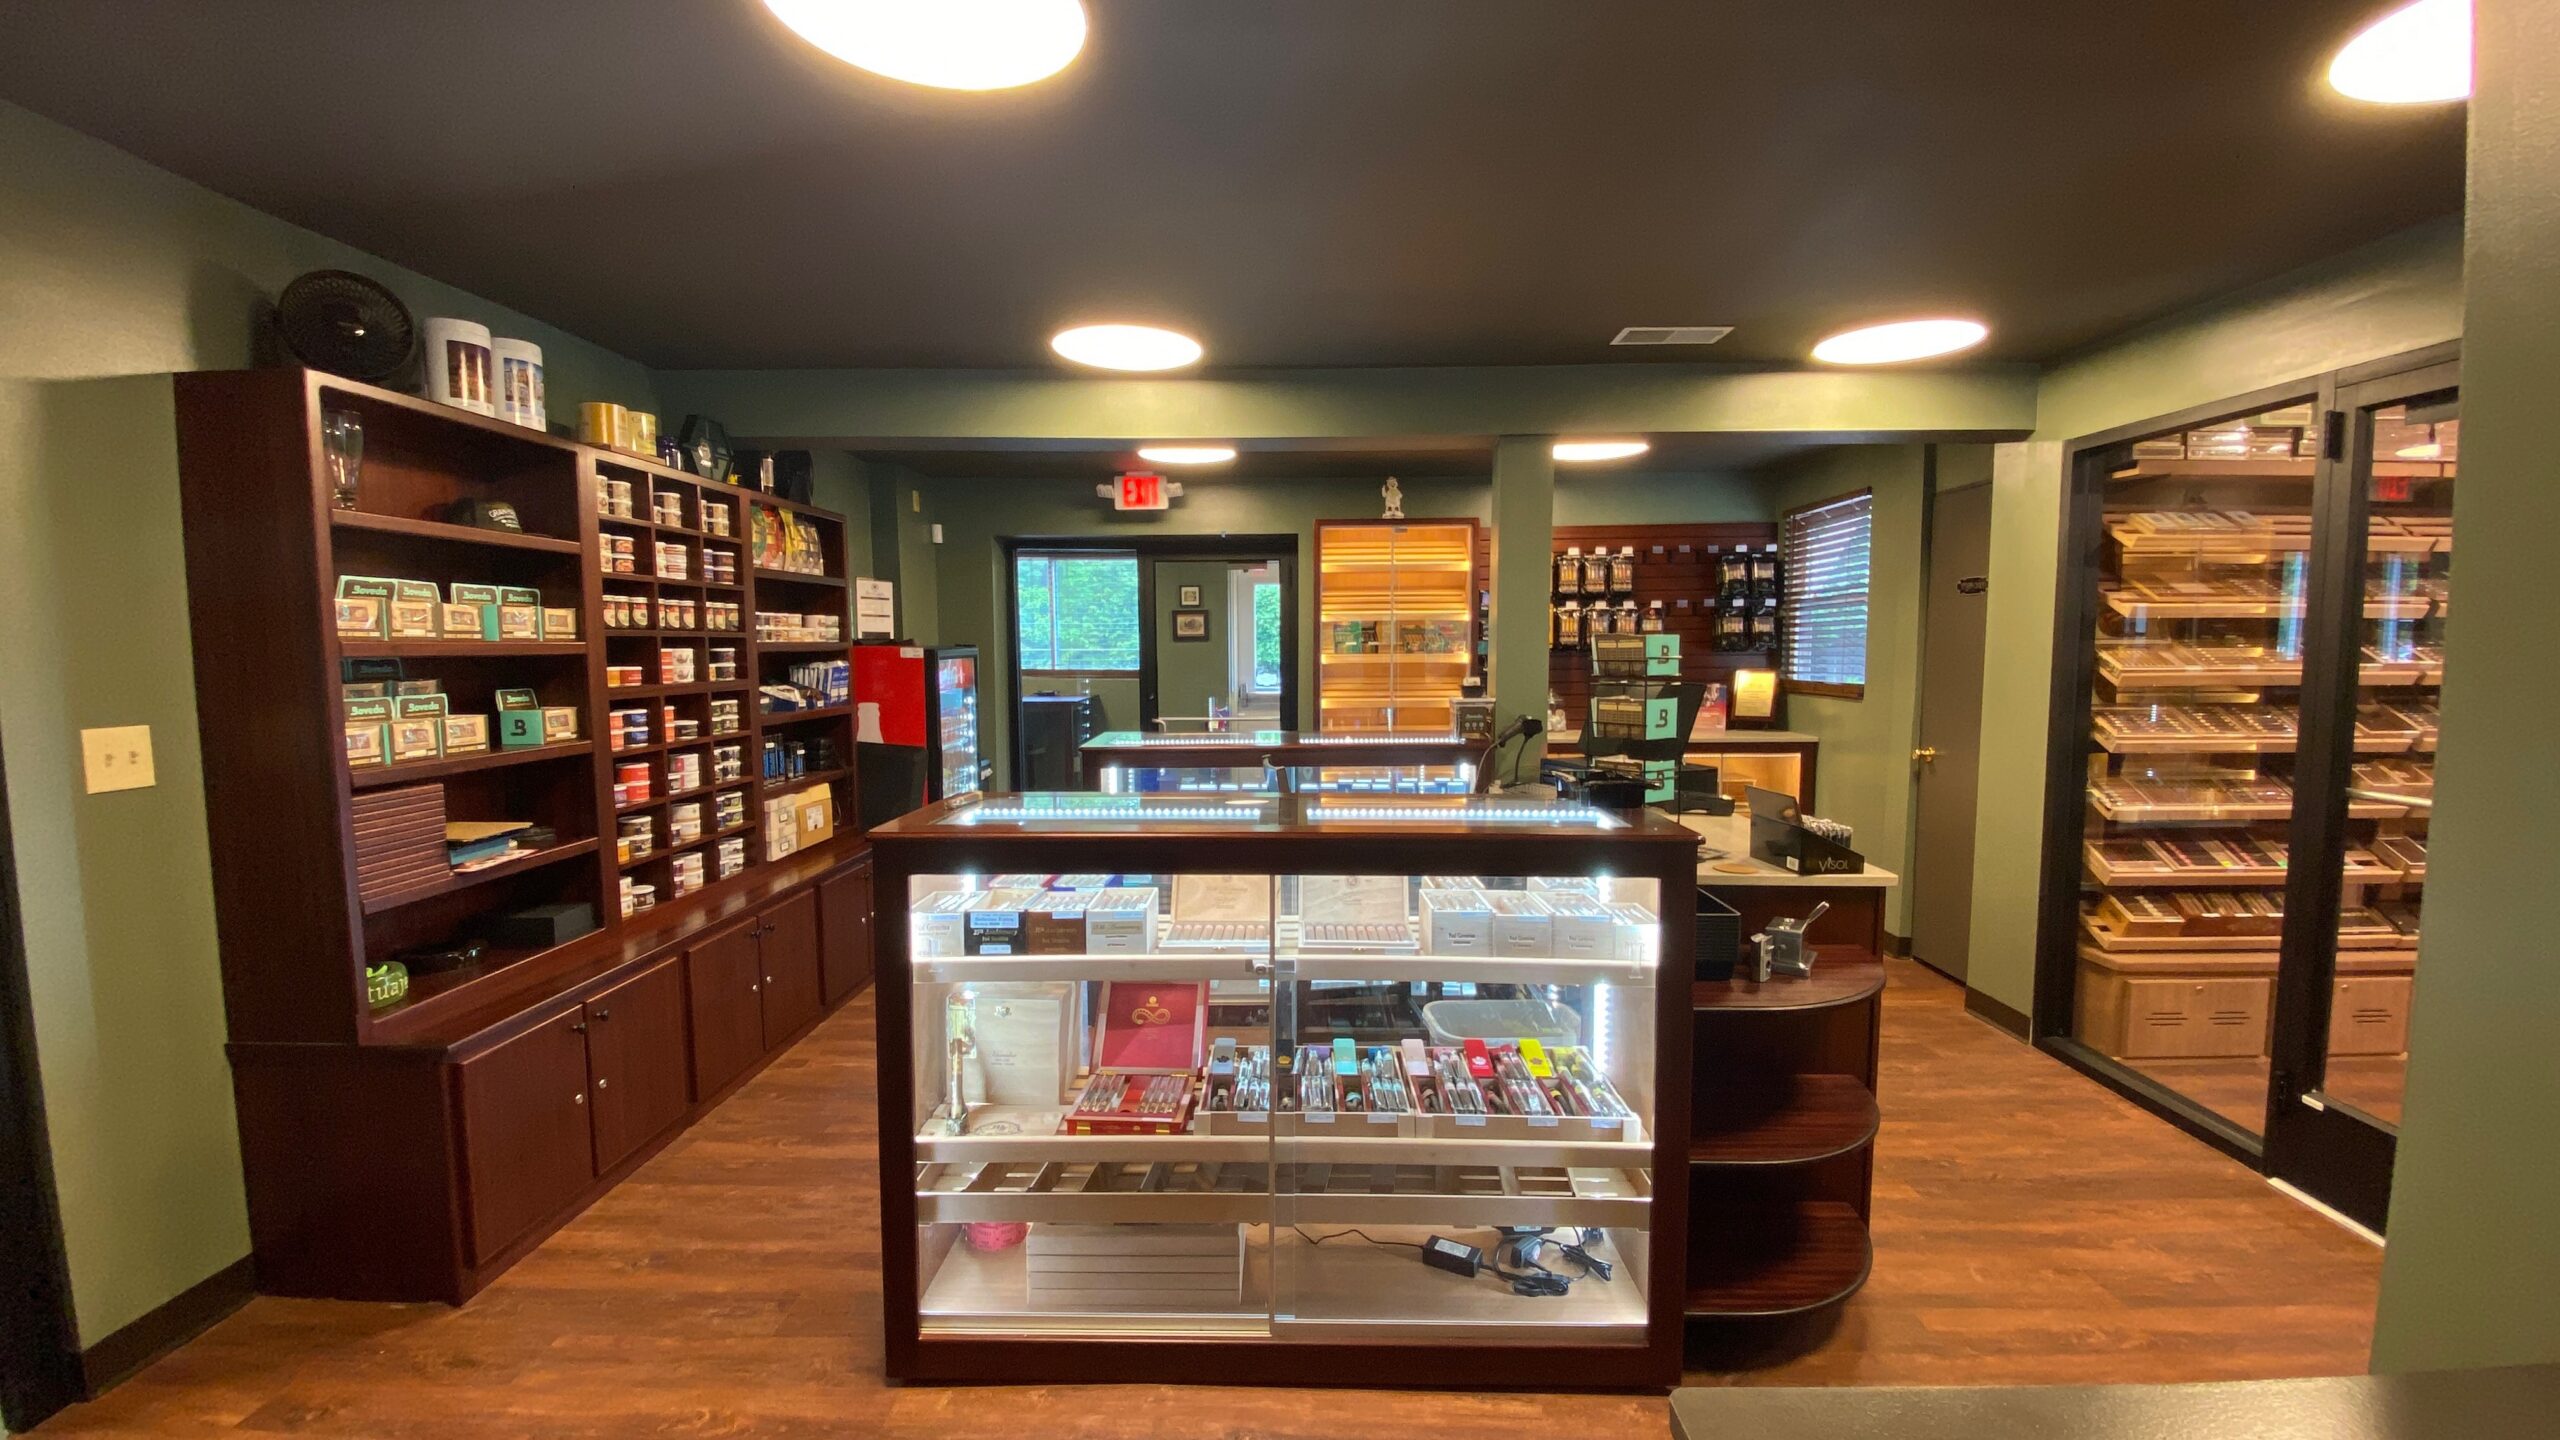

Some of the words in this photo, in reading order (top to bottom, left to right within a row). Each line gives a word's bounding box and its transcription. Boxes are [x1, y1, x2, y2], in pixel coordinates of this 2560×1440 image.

[352, 585, 387, 595] Boveda
[350, 704, 385, 715] Boveda
[407, 701, 439, 712] Boveda
